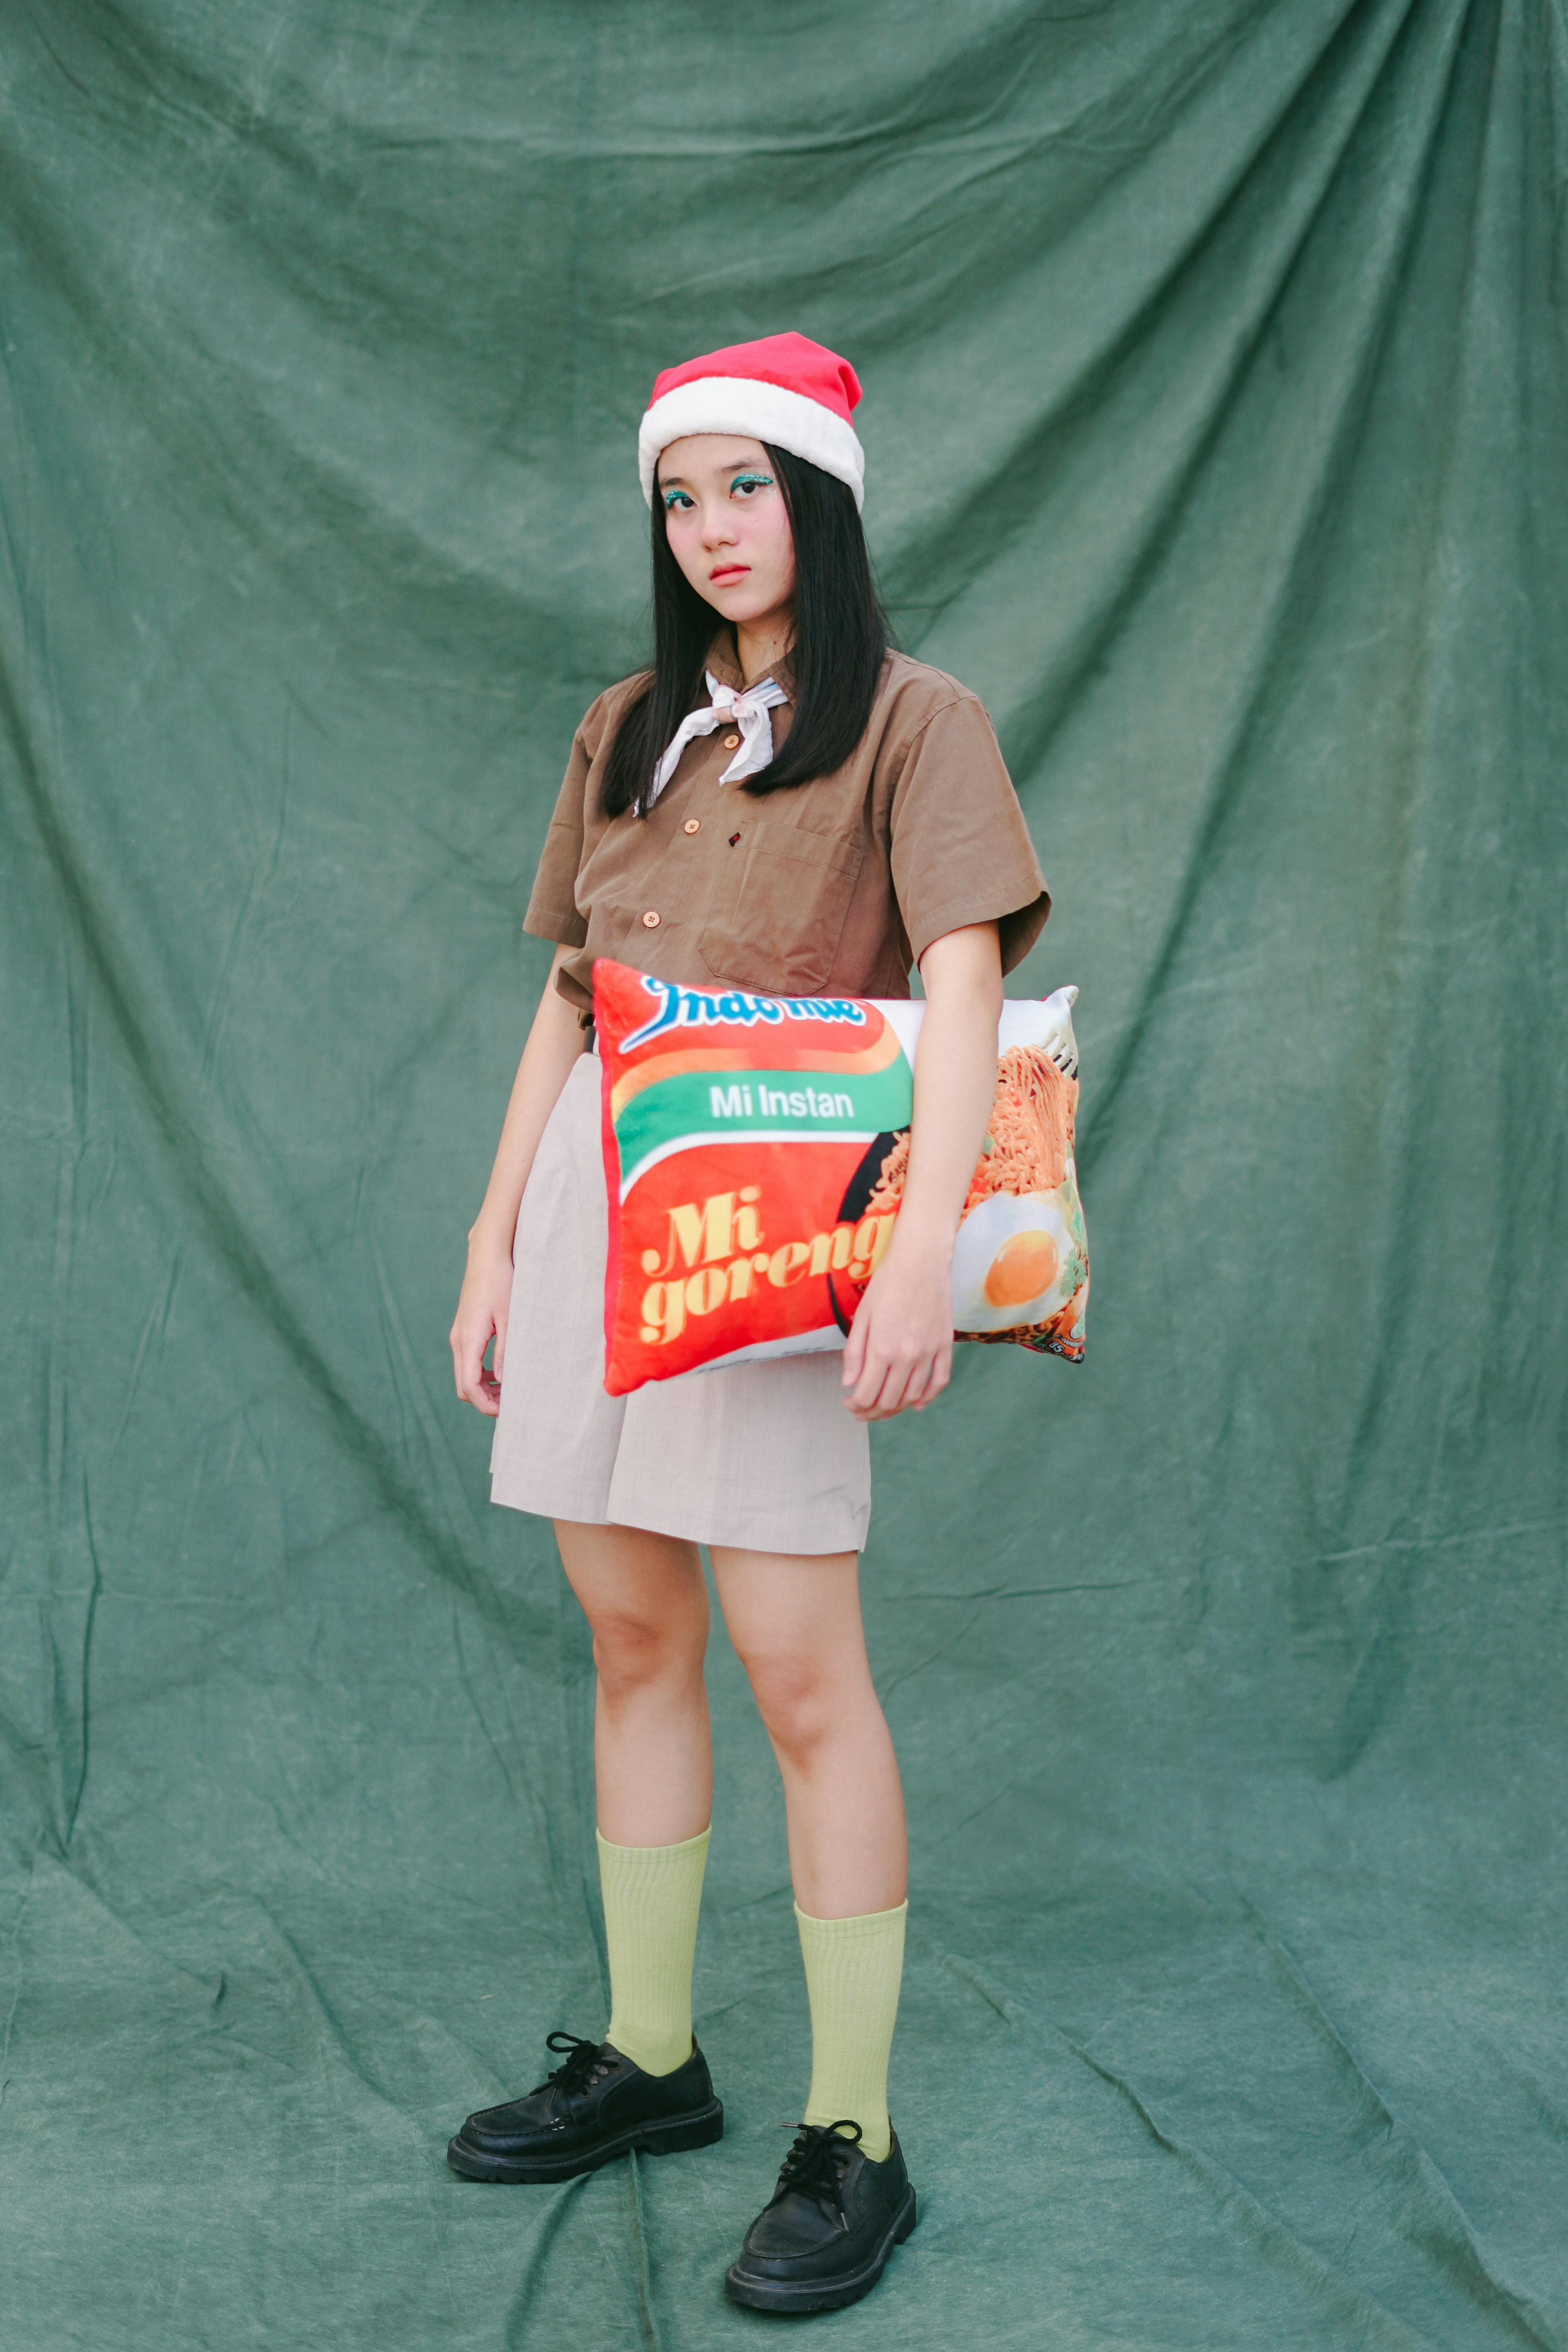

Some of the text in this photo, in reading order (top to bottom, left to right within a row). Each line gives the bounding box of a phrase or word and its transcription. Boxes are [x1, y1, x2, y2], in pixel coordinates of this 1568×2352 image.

[710, 1083, 855, 1118] Mi Instan
[641, 1185, 765, 1278] Mi
[639, 1212, 897, 1345] goreng
